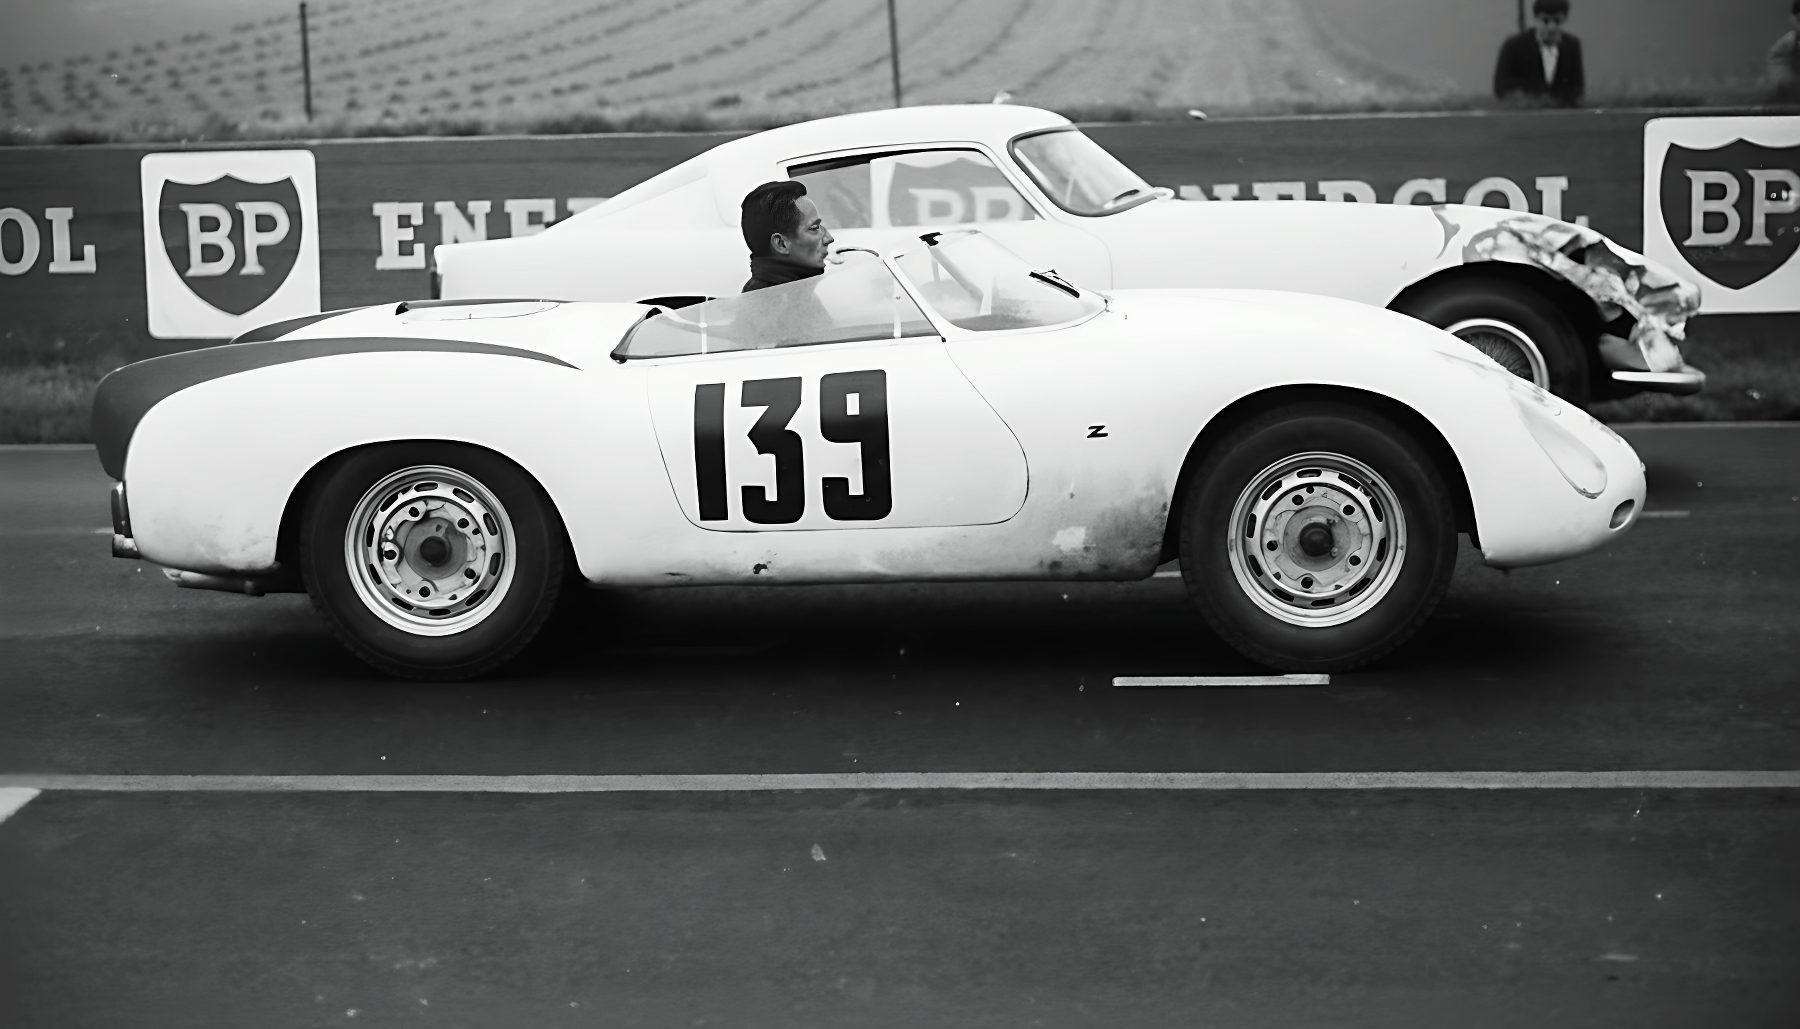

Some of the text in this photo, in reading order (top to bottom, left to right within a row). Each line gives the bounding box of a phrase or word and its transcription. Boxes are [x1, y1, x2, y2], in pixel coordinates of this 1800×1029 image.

[179, 201, 291, 277] BP
[373, 198, 607, 270] ENE
[1682, 168, 1800, 247] BP
[693, 368, 893, 524] 139
